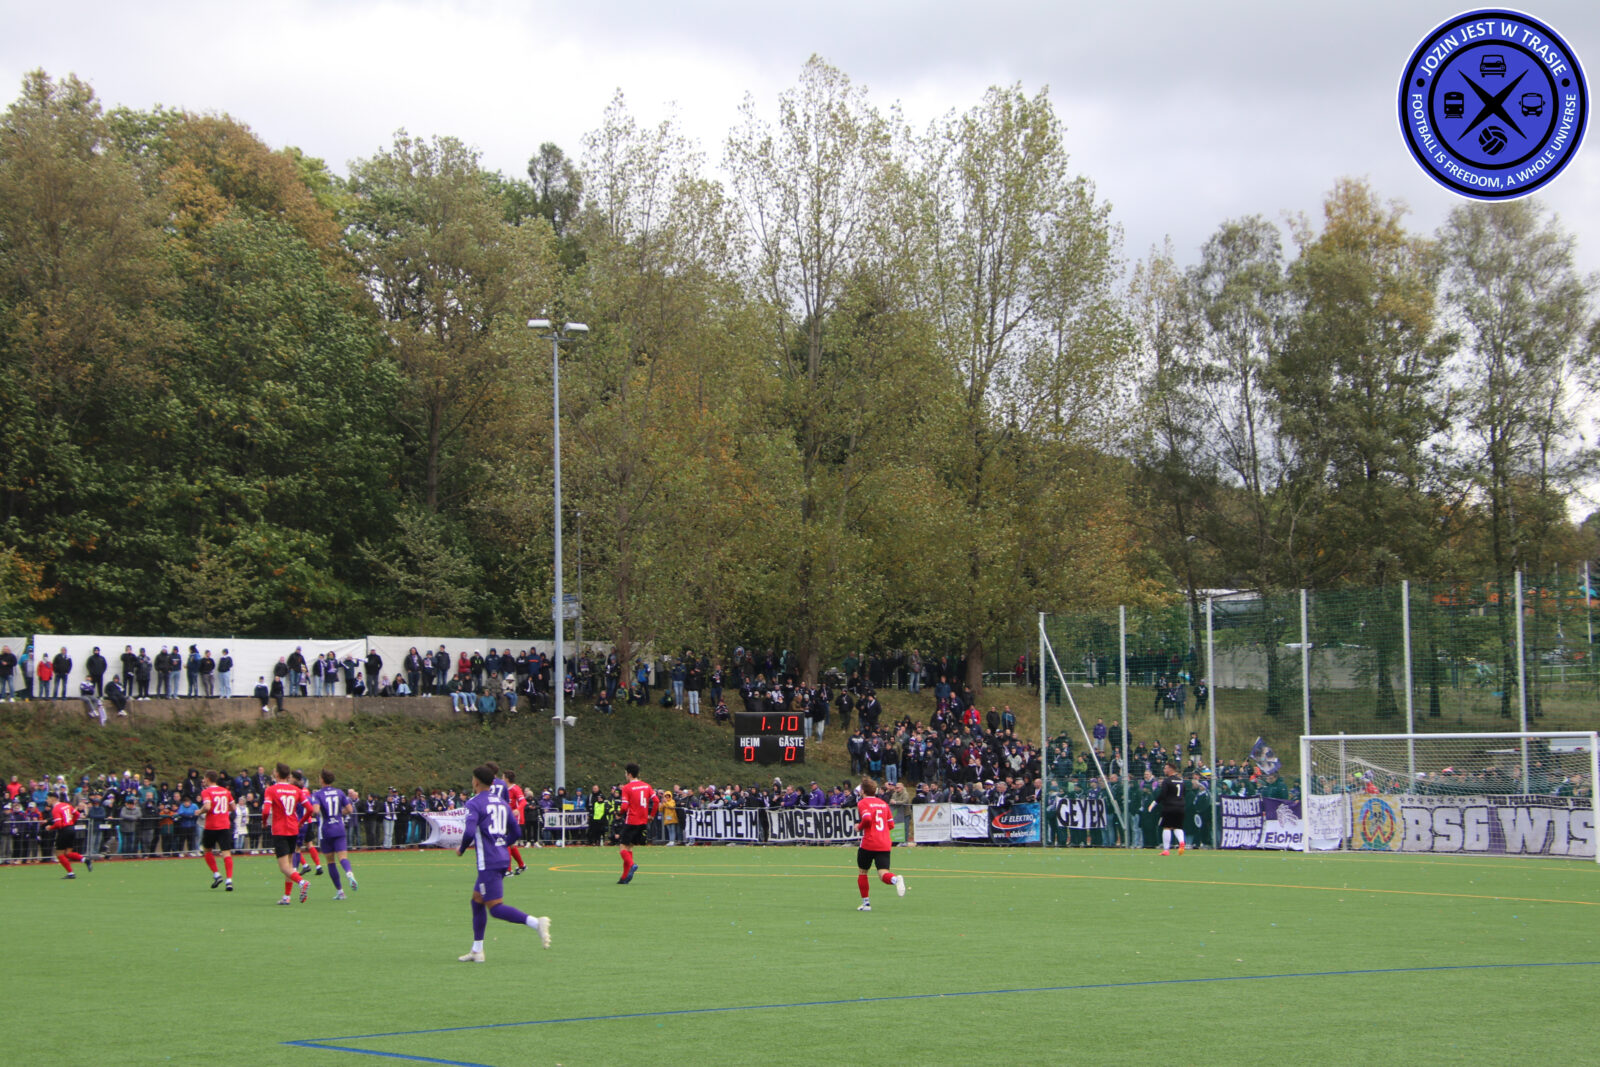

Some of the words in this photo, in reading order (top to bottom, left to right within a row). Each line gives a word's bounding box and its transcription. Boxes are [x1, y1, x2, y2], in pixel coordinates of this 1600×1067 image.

[740, 737, 760, 747] HEIM
[778, 735, 804, 747] GÄSTE
[744, 746, 755, 762] 0
[784, 746, 796, 761] 0
[640, 790, 647, 808] 4
[1175, 783, 1181, 797] 1
[213, 795, 229, 814] 20
[279, 795, 296, 816] 10
[325, 796, 340, 817] 11
[1056, 798, 1107, 828] GEYER
[1221, 797, 1260, 816] FREIHEIT
[486, 804, 508, 835] 30
[686, 810, 758, 839] THALHEIM
[768, 808, 863, 839] LANGENBACH
[875, 810, 885, 832] 5
[952, 813, 987, 827] INJOY
[1009, 814, 1033, 823] ELEKTRO
[1401, 805, 1490, 853] BSG
